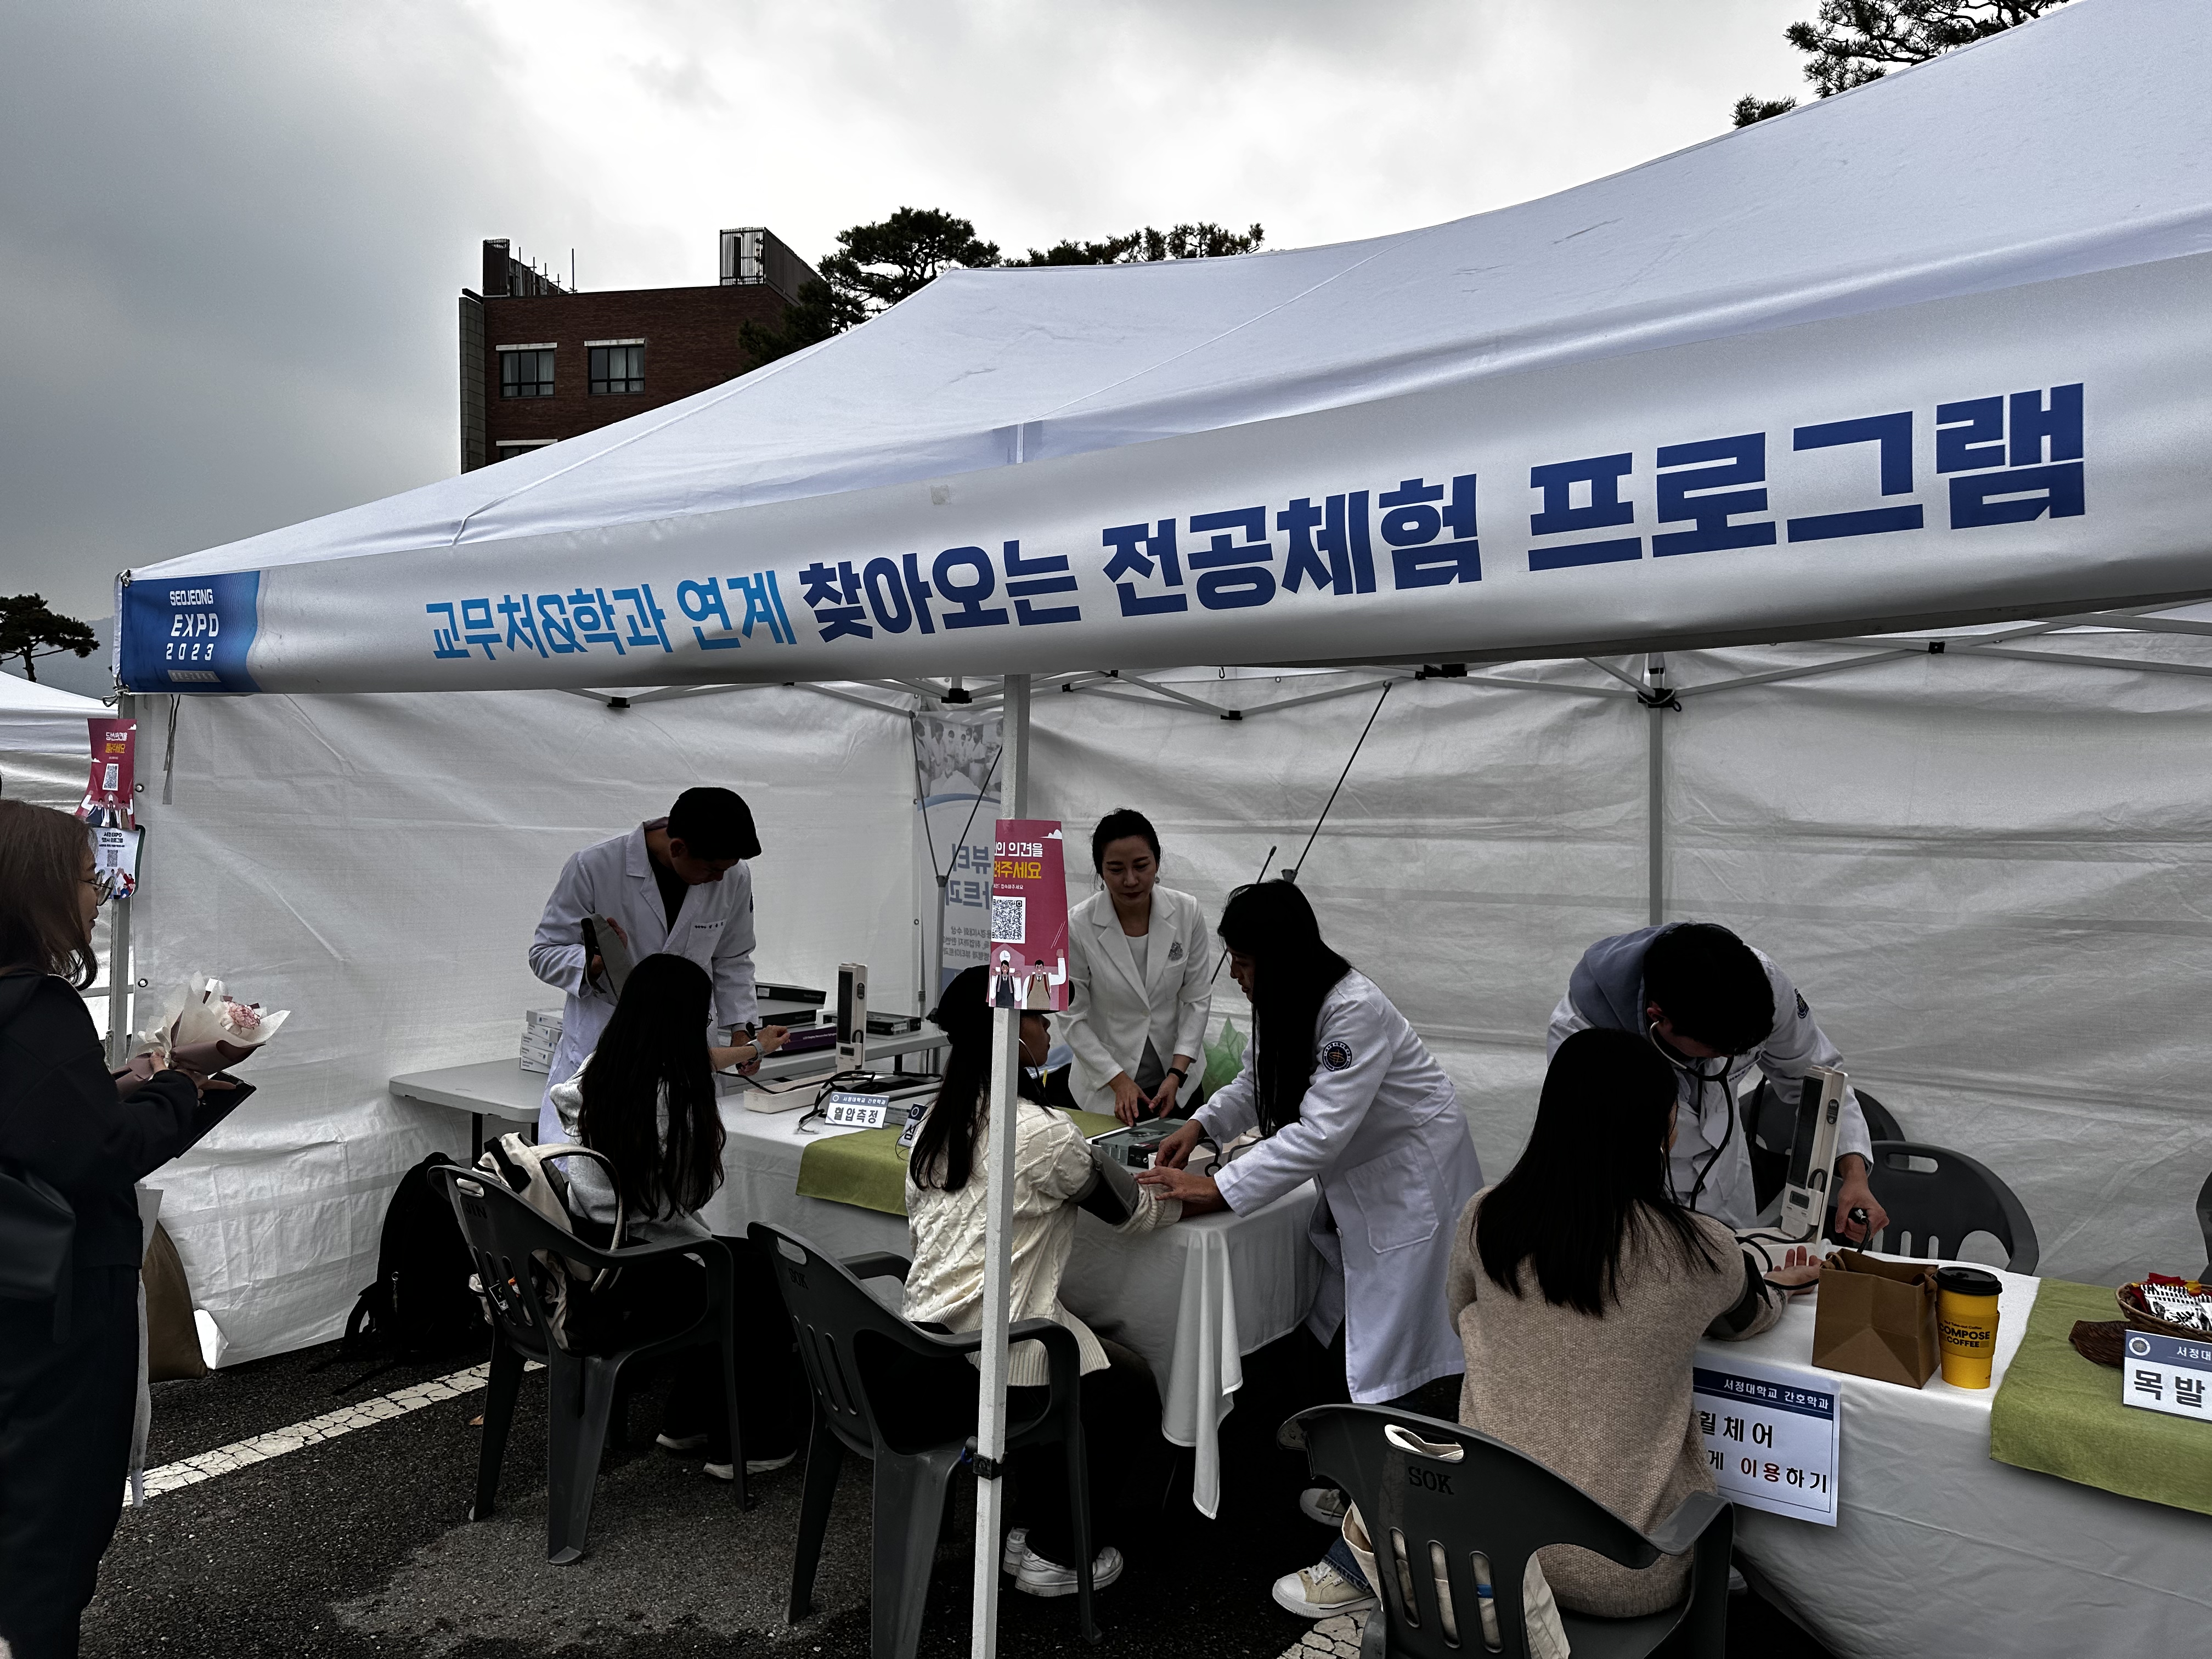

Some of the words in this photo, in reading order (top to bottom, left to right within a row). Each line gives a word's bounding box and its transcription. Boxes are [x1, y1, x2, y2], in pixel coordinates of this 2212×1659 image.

[426, 584, 672, 660] 교무처&학과
[677, 571, 797, 650] 연계
[799, 540, 1081, 644] 찾아오는
[1103, 474, 1481, 617] 전공체험
[1528, 383, 2084, 571] 프로그램
[170, 589, 213, 606] SEOJEONG
[171, 613, 219, 636] EXPO
[166, 643, 214, 661] 2023
[1008, 842, 1043, 857] 의견을
[834, 1107, 878, 1124] 혈압측정
[788, 1267, 809, 1289] SOK
[1939, 1322, 1990, 1340] COMPOSE
[1946, 1336, 1979, 1347] COFFEE
[1724, 1379, 1778, 1399] 서정대학교
[1784, 1391, 1829, 1410] 간호학과
[2134, 1369, 2205, 1408] 목발
[1408, 1465, 1454, 1495] SOK
[1741, 1457, 1827, 1493] 이용하기
